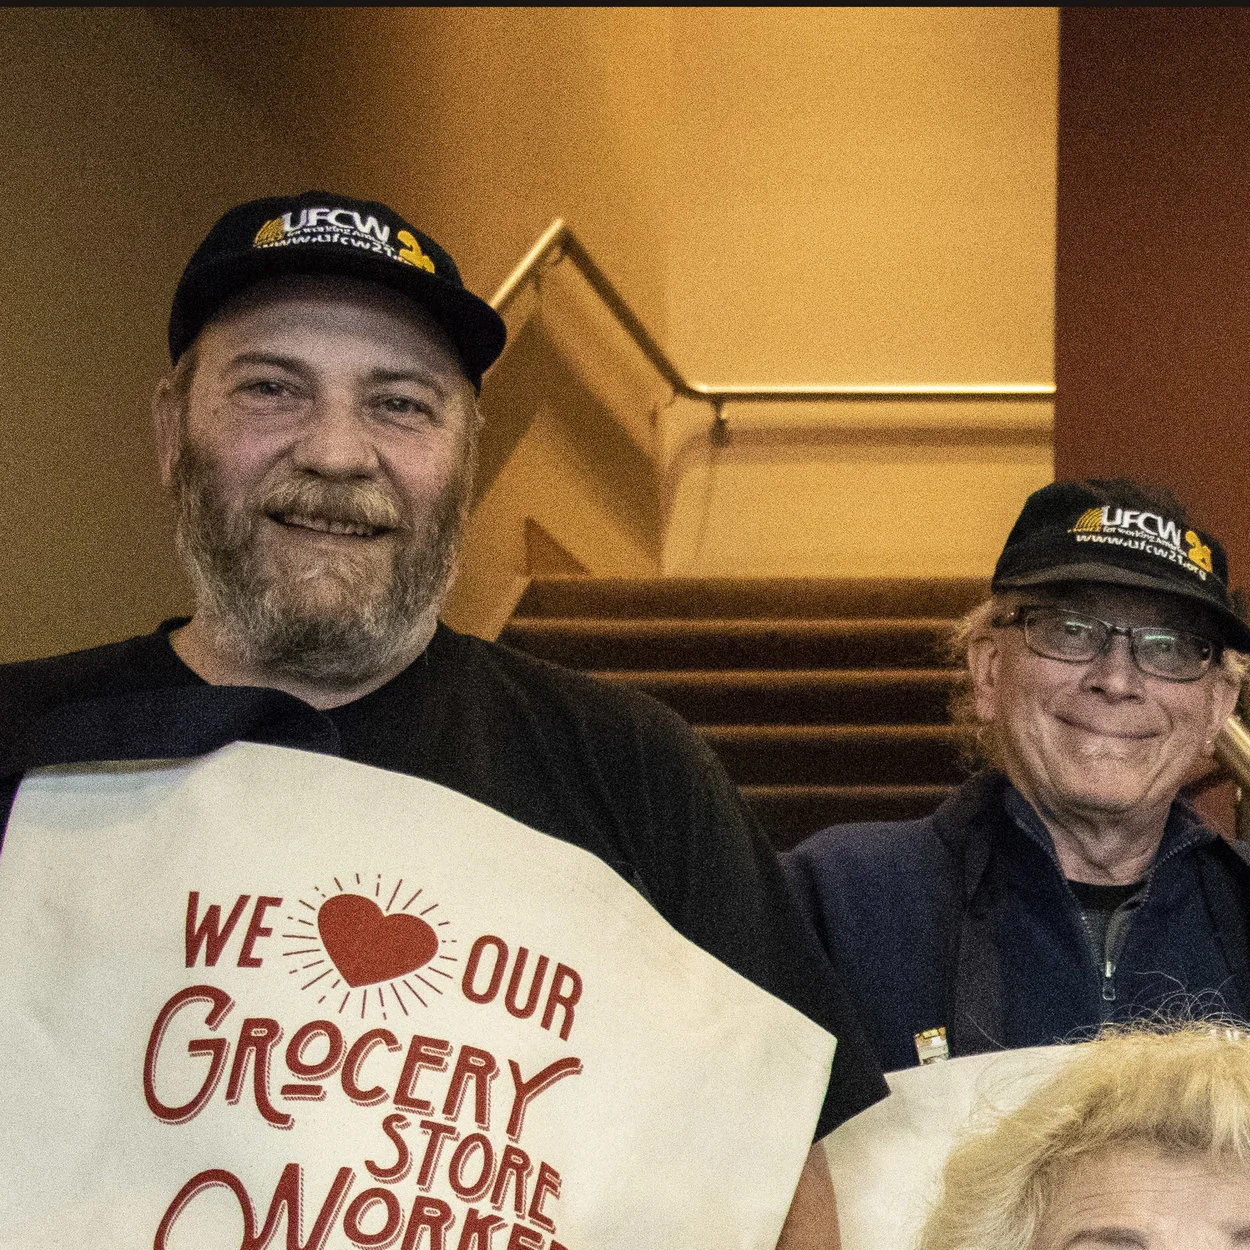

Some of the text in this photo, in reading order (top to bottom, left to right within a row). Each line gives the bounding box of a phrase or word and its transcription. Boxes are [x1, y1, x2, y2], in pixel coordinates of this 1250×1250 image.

[282, 208, 391, 244] UFCW
[1076, 534, 1207, 581] www.ufcw21.org
[1101, 505, 1181, 547] UFCW
[184, 891, 584, 1041] WE OUR
[142, 984, 584, 1143] GROCERY
[365, 1113, 563, 1235] STORE
